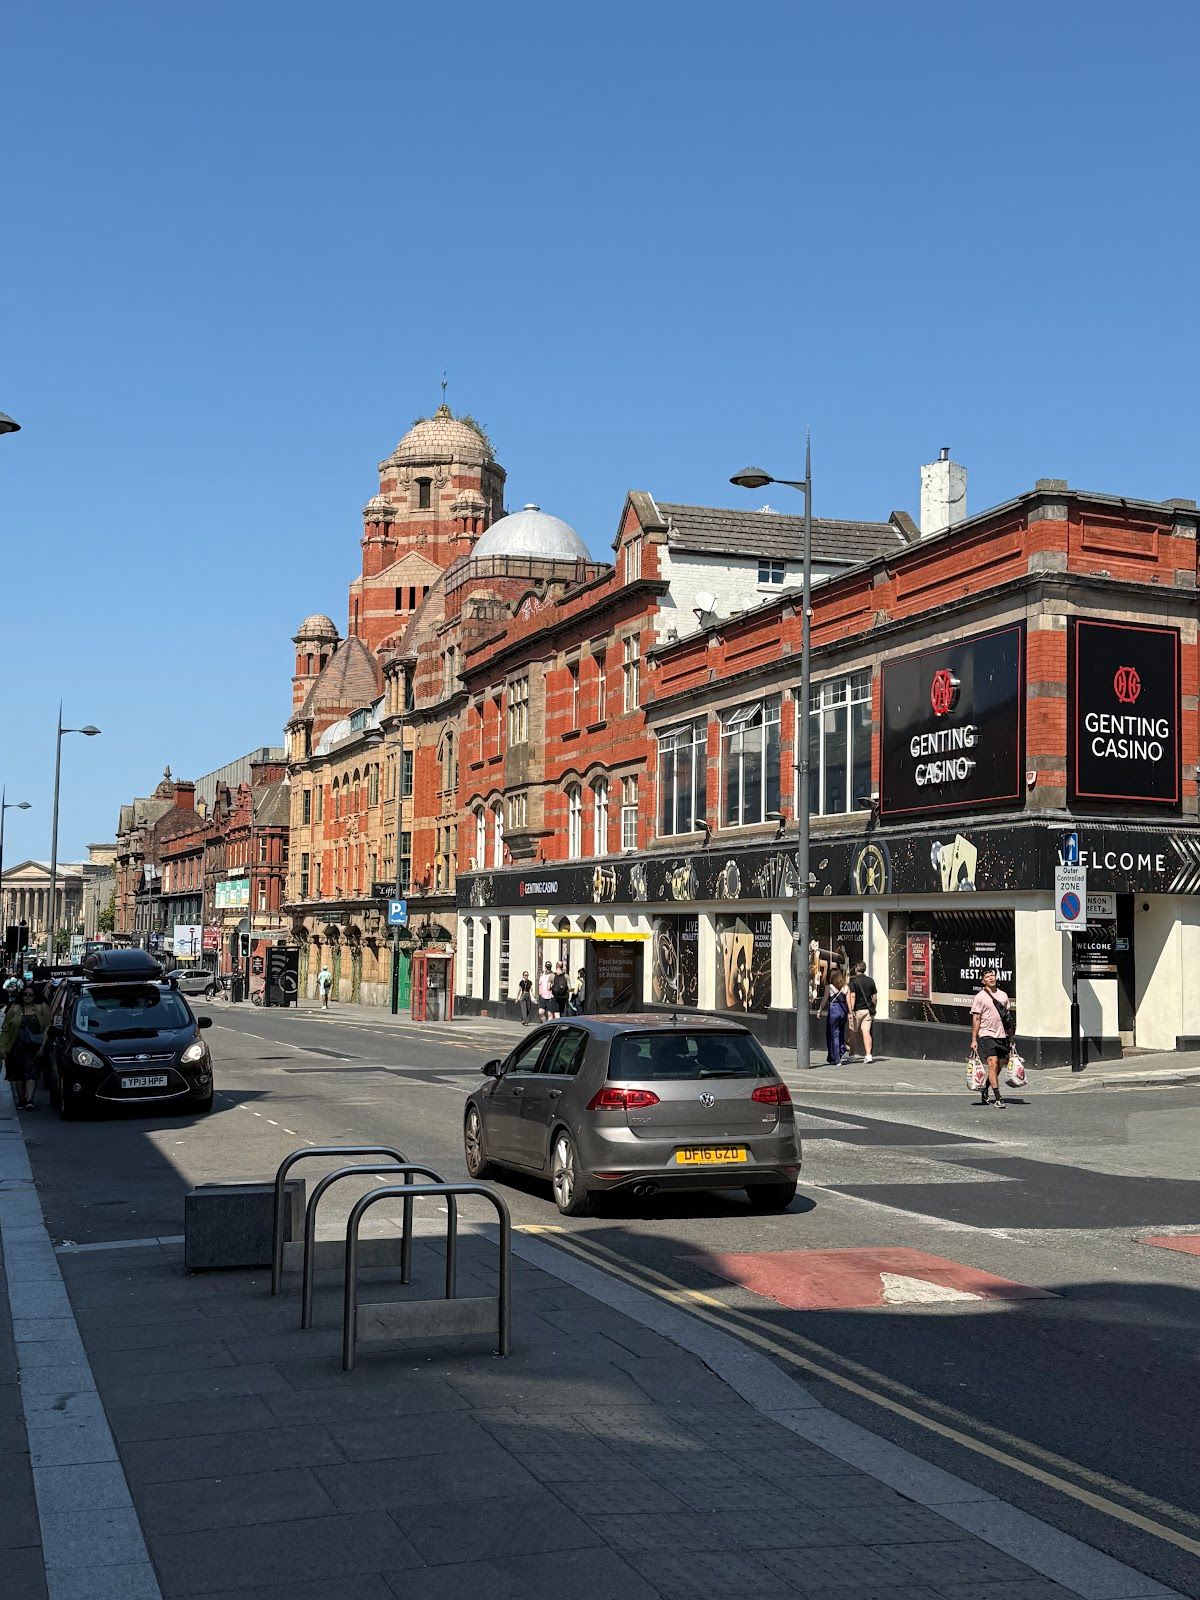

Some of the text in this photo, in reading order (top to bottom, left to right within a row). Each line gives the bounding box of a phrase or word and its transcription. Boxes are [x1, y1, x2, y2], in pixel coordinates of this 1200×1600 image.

[1085, 712, 1169, 738] GENTING
[910, 724, 975, 758] GENTING
[1091, 737, 1163, 762] CASINO
[915, 757, 970, 786] CASINO
[542, 881, 558, 893] CASINO
[391, 902, 402, 915] P
[685, 921, 698, 931] LIVE
[756, 920, 772, 933] LIVE
[969, 957, 986, 968] HOU
[960, 968, 1012, 981] RESTANT
[128, 1076, 164, 1087] YP13 HPF
[684, 1146, 738, 1160] DF16 GZD
